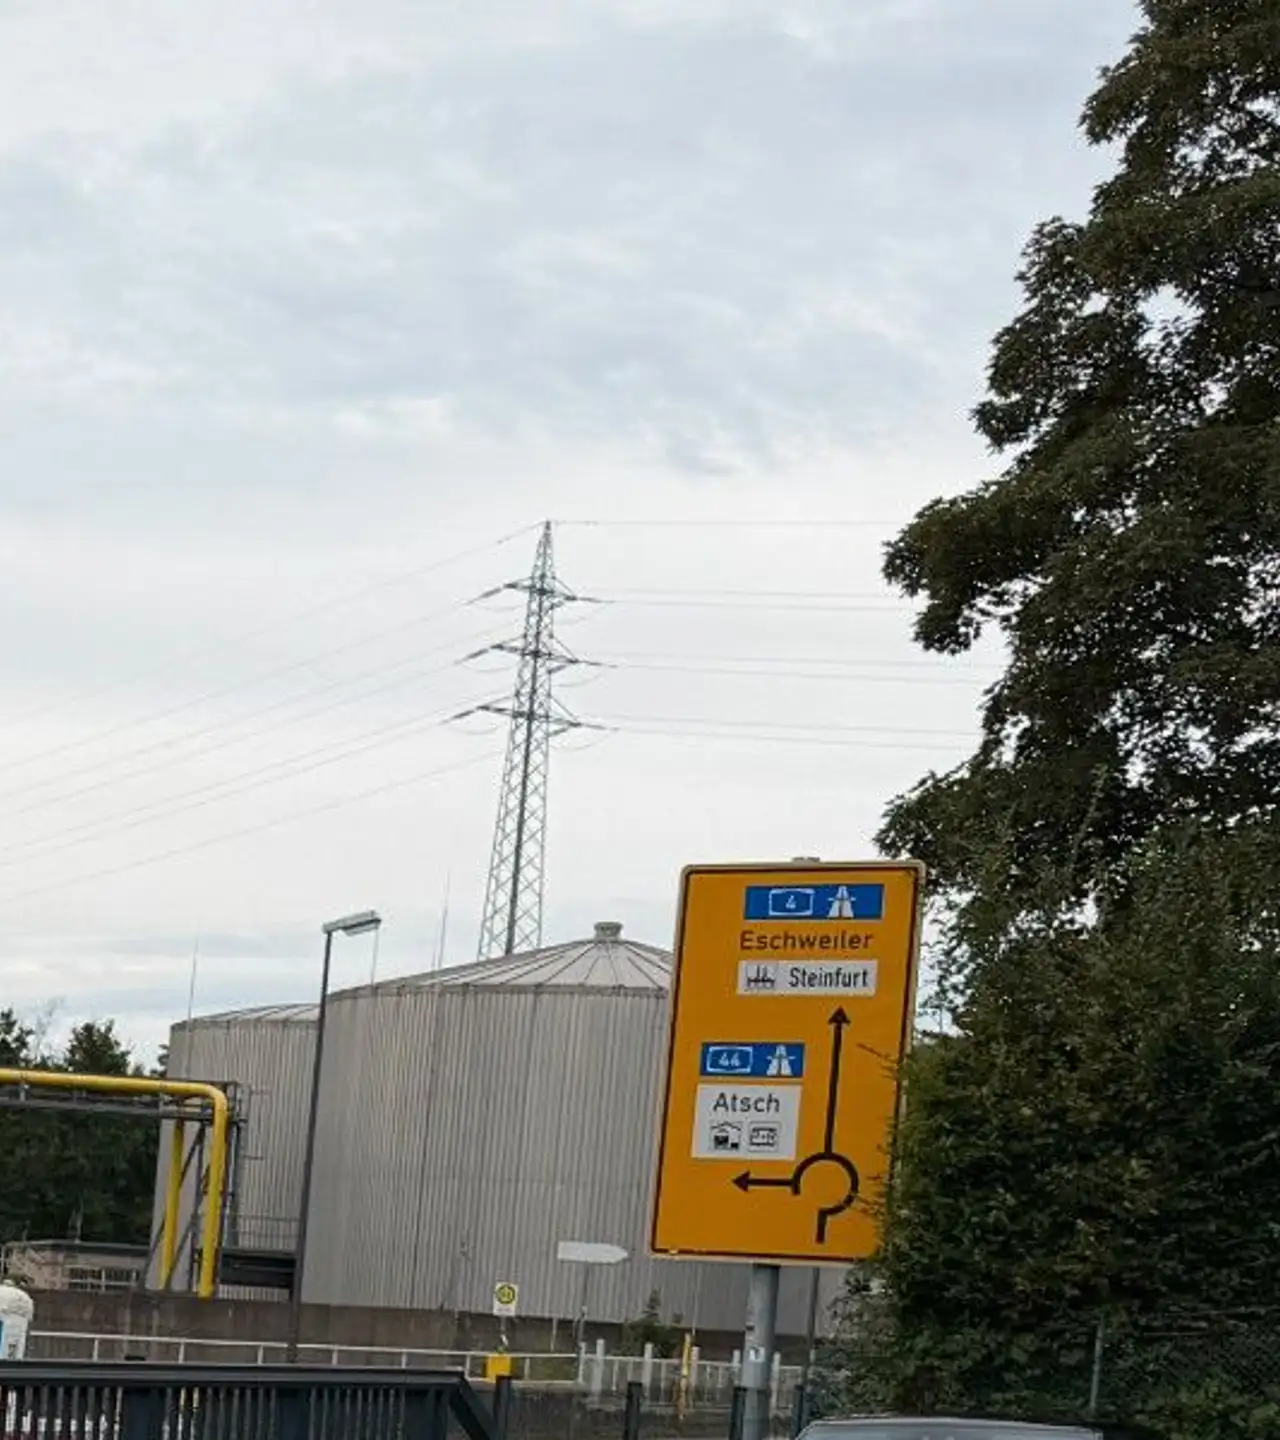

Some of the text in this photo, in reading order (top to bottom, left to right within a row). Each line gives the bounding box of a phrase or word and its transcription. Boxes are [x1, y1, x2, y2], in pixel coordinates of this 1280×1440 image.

[740, 930, 874, 951] Eschweiler
[788, 967, 868, 988] Steinfurt
[713, 1092, 780, 1113] Atsch
